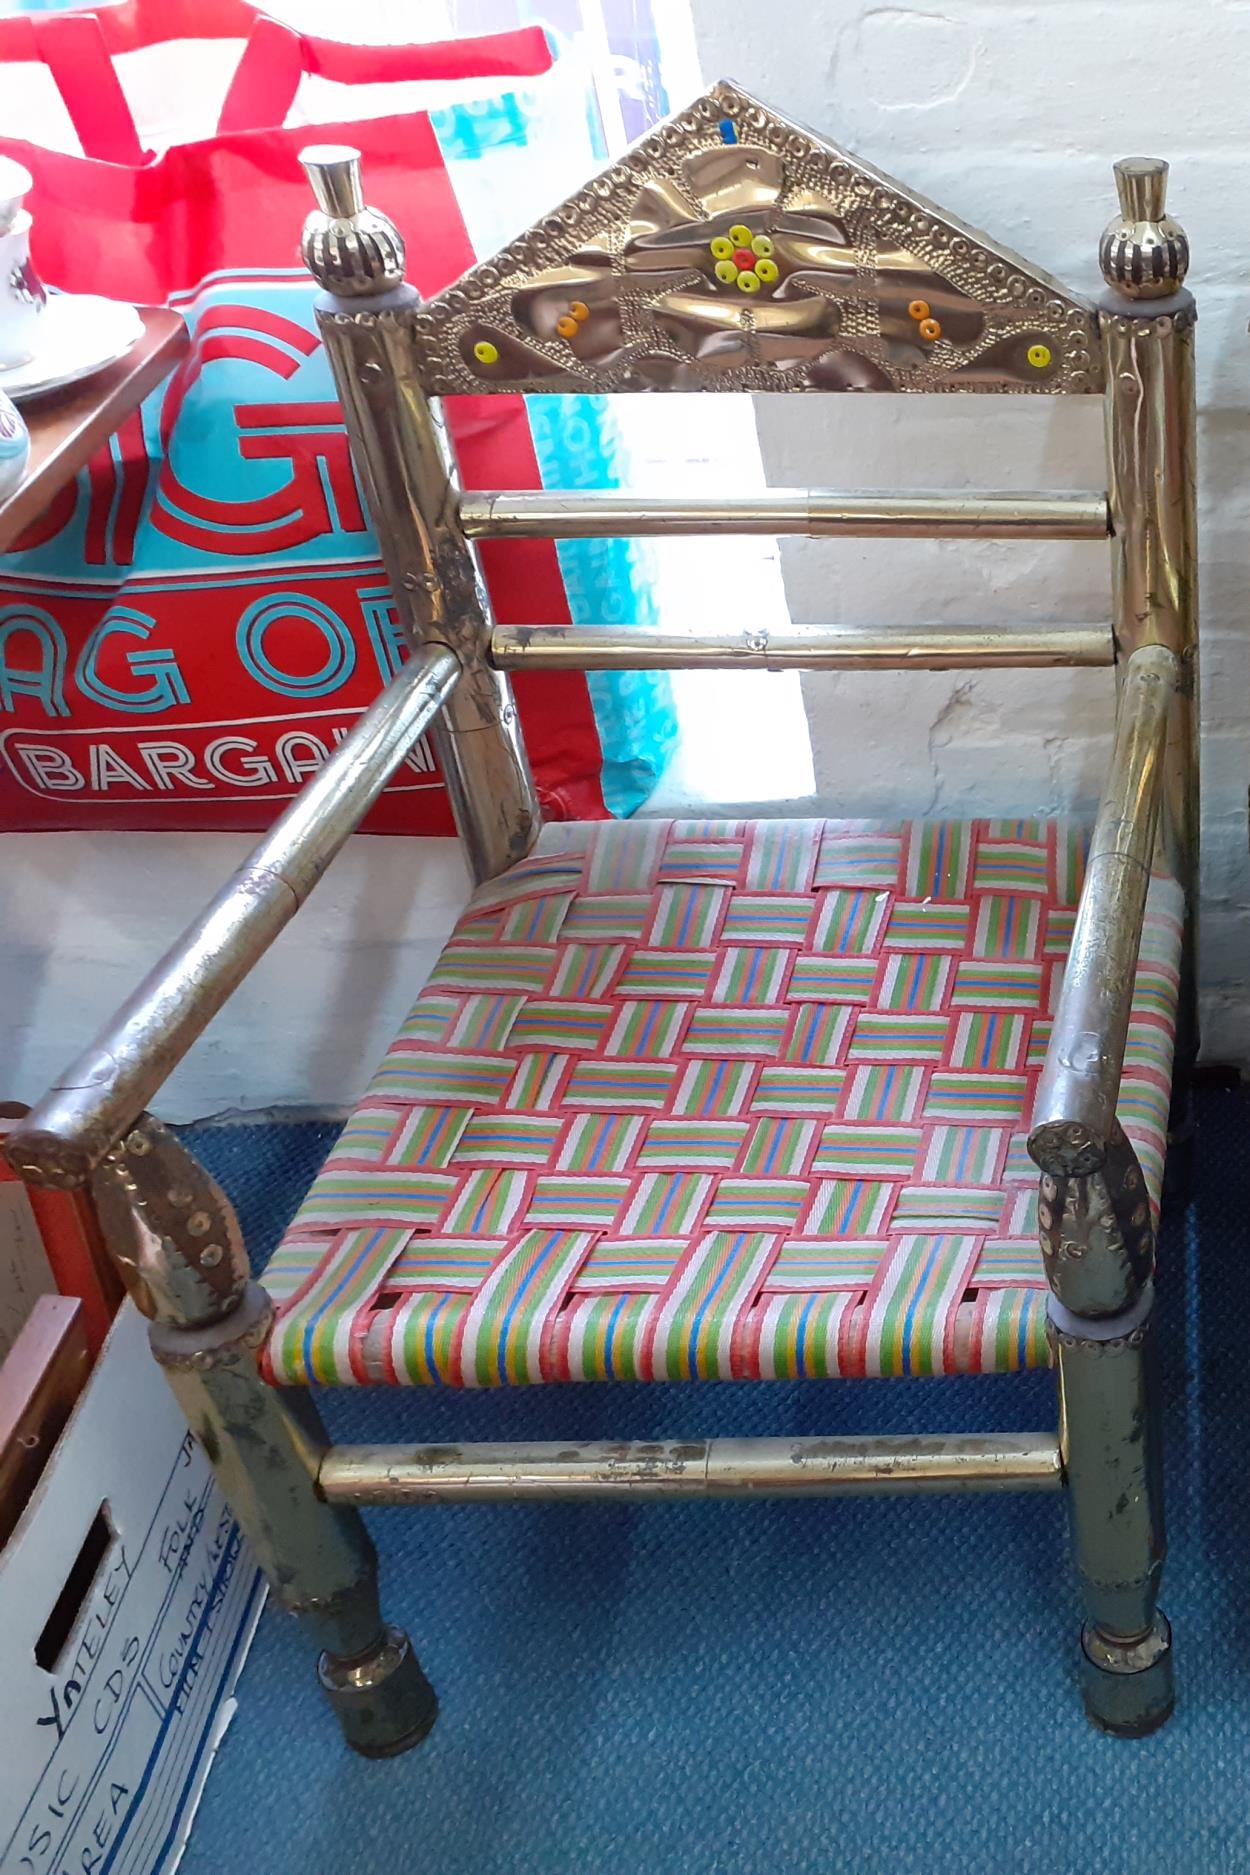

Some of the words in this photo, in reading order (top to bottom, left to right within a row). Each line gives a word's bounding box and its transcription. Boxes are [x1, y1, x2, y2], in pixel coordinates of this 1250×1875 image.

[0, 304, 367, 565] IG
[0, 604, 191, 717] AG
[158, 1488, 198, 1574] FOLK
[19, 1768, 80, 1875] SIC
[93, 1636, 140, 1735] CDS
[62, 1782, 129, 1875] REA
